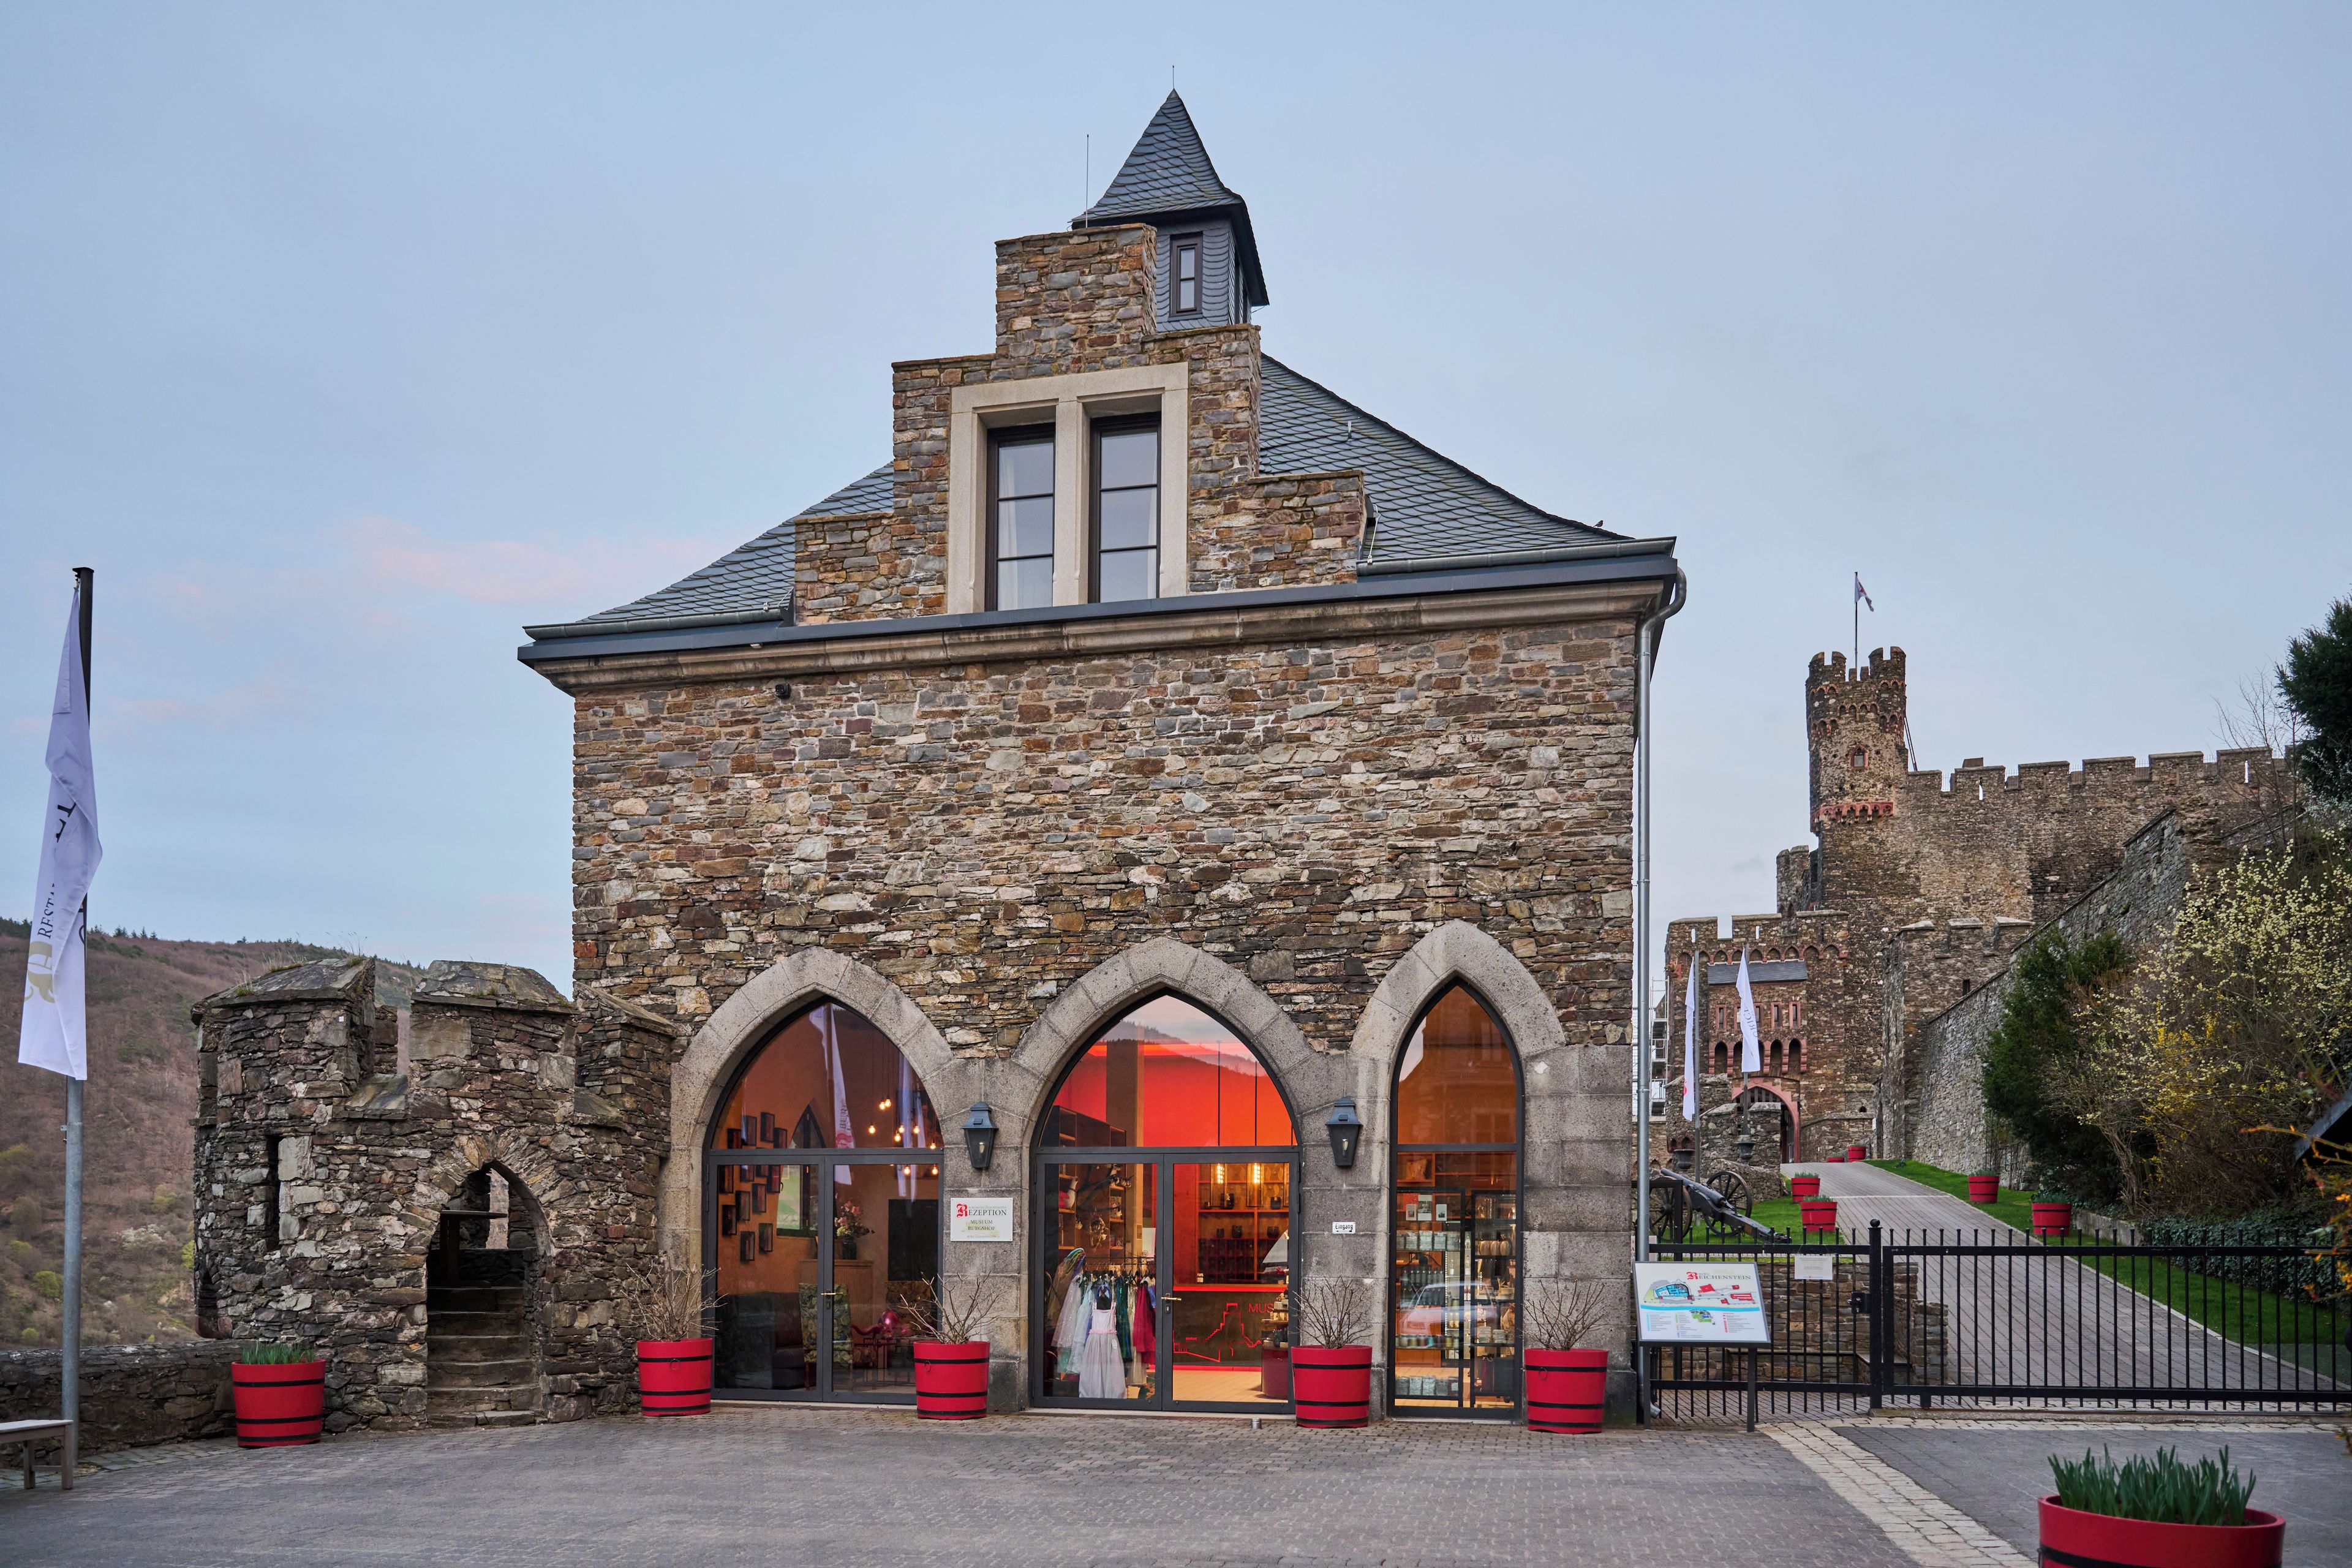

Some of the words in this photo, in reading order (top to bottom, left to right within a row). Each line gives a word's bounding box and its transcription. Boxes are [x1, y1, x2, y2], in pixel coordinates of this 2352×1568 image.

[956, 1204, 1007, 1218] REZEPTION
[1686, 1272, 1751, 1280] REICHENSTEIN
[1248, 1303, 1274, 1313] MUS
